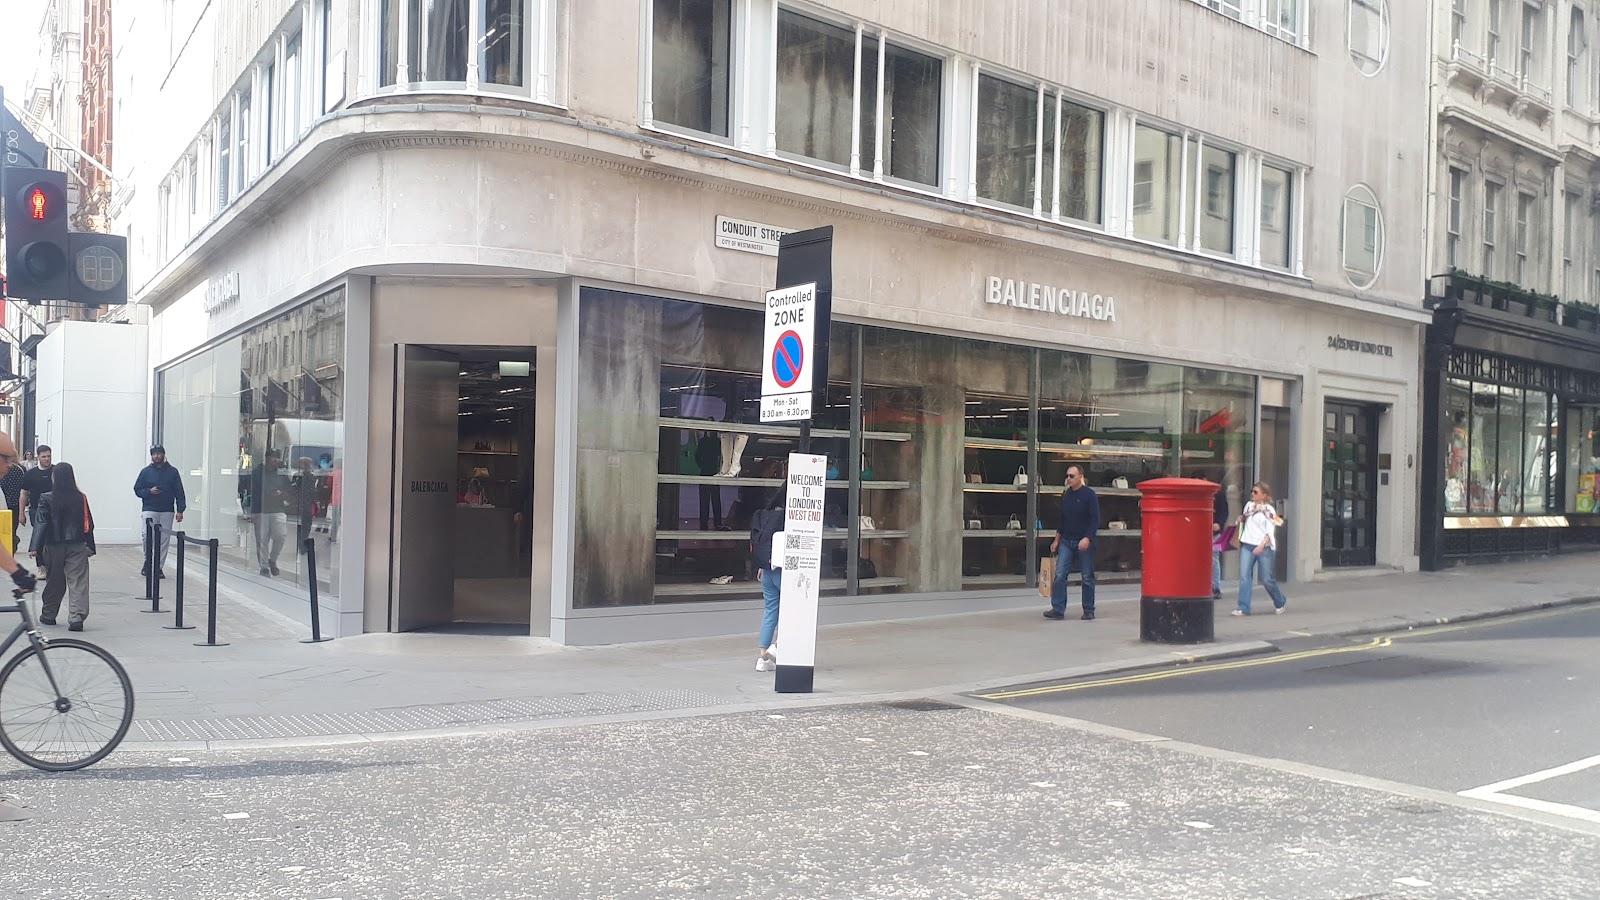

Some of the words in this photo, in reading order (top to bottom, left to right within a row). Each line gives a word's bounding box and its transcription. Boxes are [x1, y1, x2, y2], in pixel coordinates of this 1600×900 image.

[722, 220, 757, 237] CONDUIT
[760, 227, 790, 242] STRE
[737, 241, 764, 251] WESTMINSTER
[769, 289, 812, 308] Controlled
[985, 275, 1116, 322] BALENCIAGA
[774, 307, 804, 327] ZONE
[773, 398, 785, 407] Mon
[788, 396, 799, 406] Sat
[800, 408, 810, 417] pm
[410, 480, 449, 493] BALENCIAGA
[791, 474, 823, 487] WELCOME
[801, 486, 811, 498] TO
[789, 498, 822, 510] LONDON'S
[788, 509, 807, 521] WEST
[807, 510, 821, 522] END
